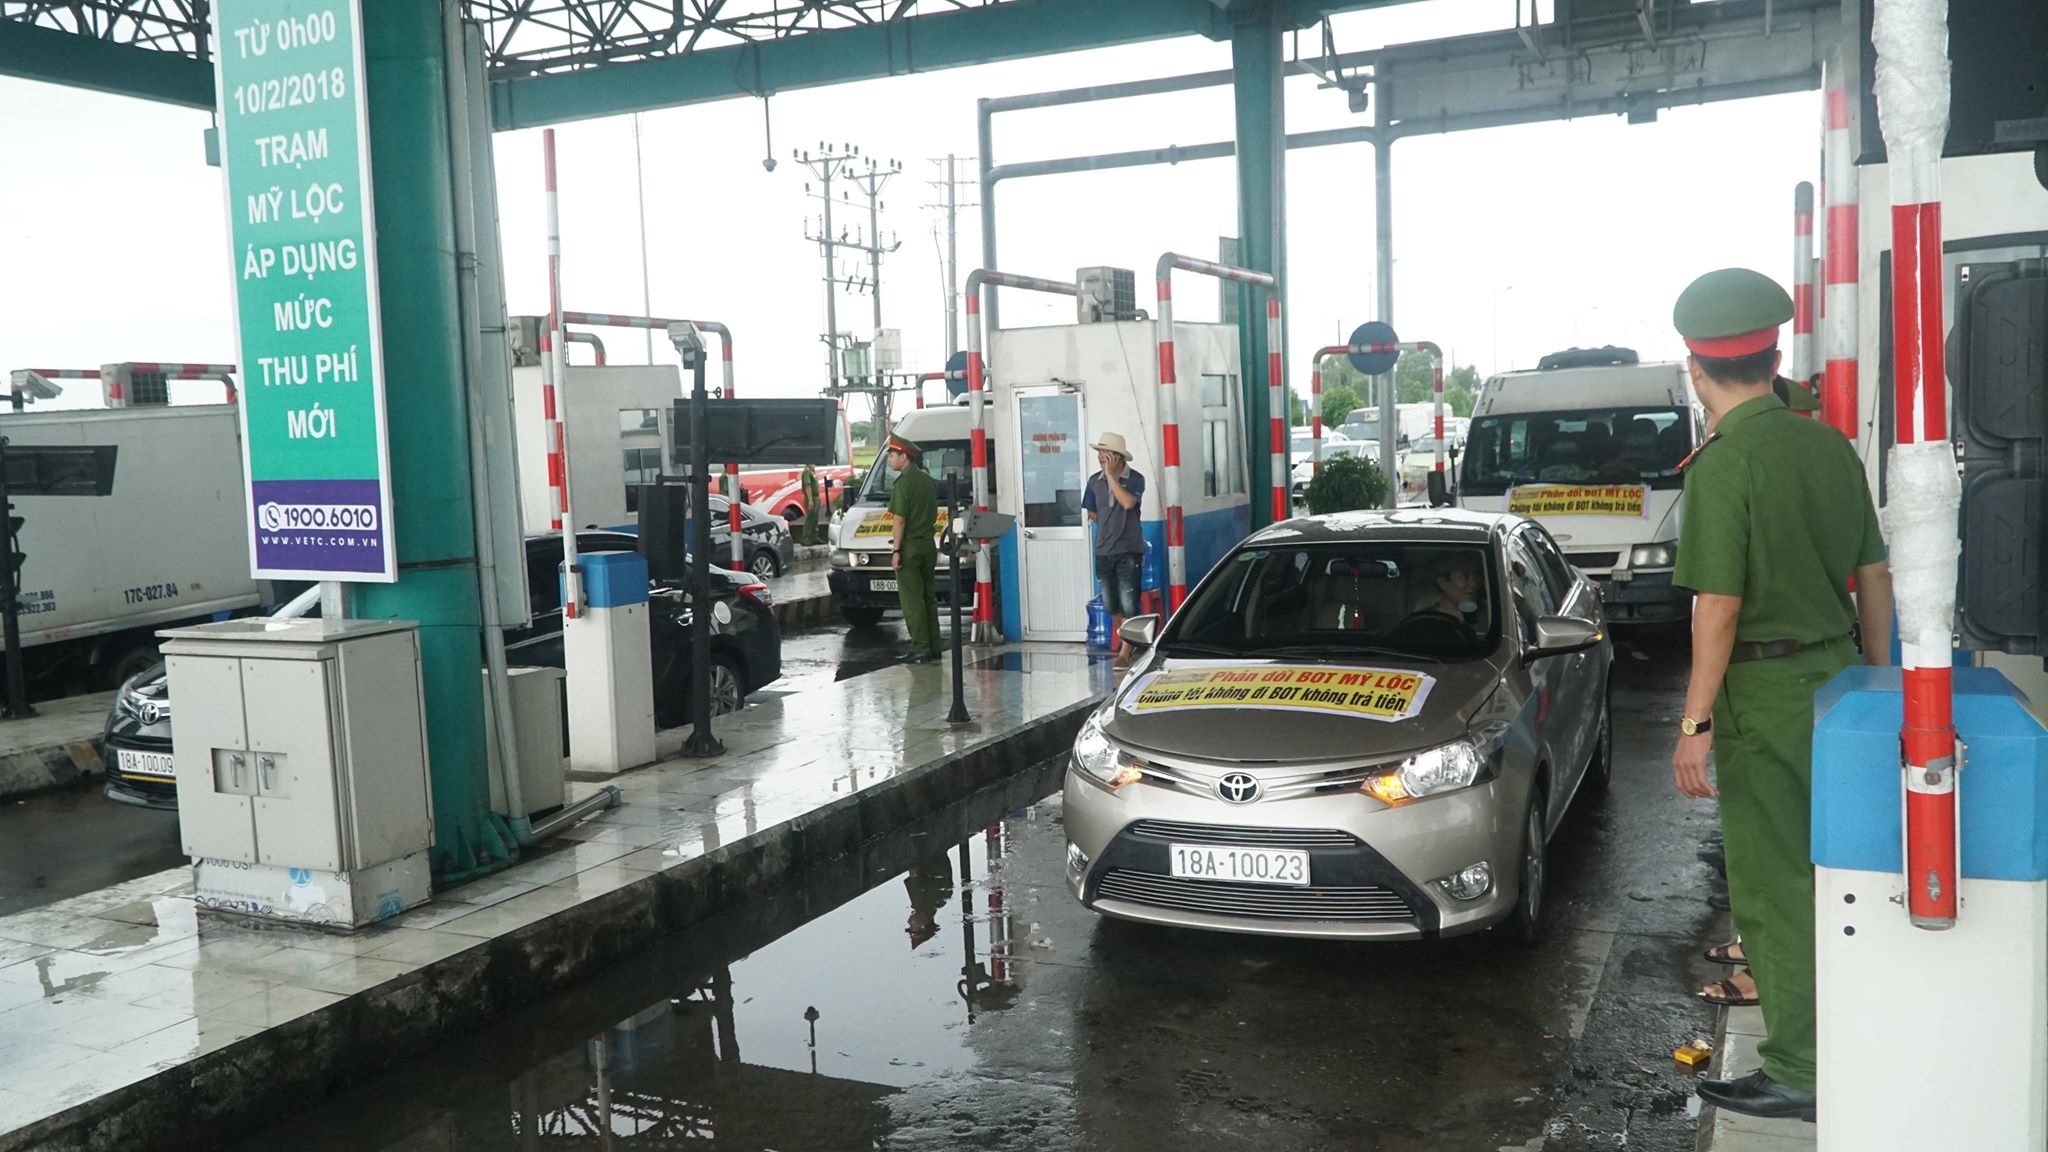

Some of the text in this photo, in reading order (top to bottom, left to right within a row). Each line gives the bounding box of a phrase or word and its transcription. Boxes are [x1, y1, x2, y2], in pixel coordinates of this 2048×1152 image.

[234, 10, 336, 59] TỪ 0h00
[234, 67, 346, 116] 10/2/2018
[255, 127, 329, 170] TRẠM
[247, 182, 345, 225] MỸ LỘC
[243, 238, 358, 281] ÁP DỤNG
[273, 293, 333, 331] MỨC
[257, 345, 358, 386] THU PHÍ
[287, 402, 337, 439] MỚI
[284, 507, 373, 528] 1900.6010
[261, 536, 378, 547] WWW.VETC.COM.VN
[1204, 687, 1250, 700] không
[1251, 686, 1269, 699] đi
[1269, 686, 1301, 699] BOT
[1300, 688, 1348, 705] không
[1350, 690, 1374, 706] trả
[1374, 691, 1405, 711] tiền
[1296, 671, 1337, 684] BOT
[1338, 672, 1372, 687] MỸ
[1375, 675, 1415, 692] LỘC
[120, 752, 173, 773] 18A-100.09
[1178, 849, 1303, 881] 18A-100.23
